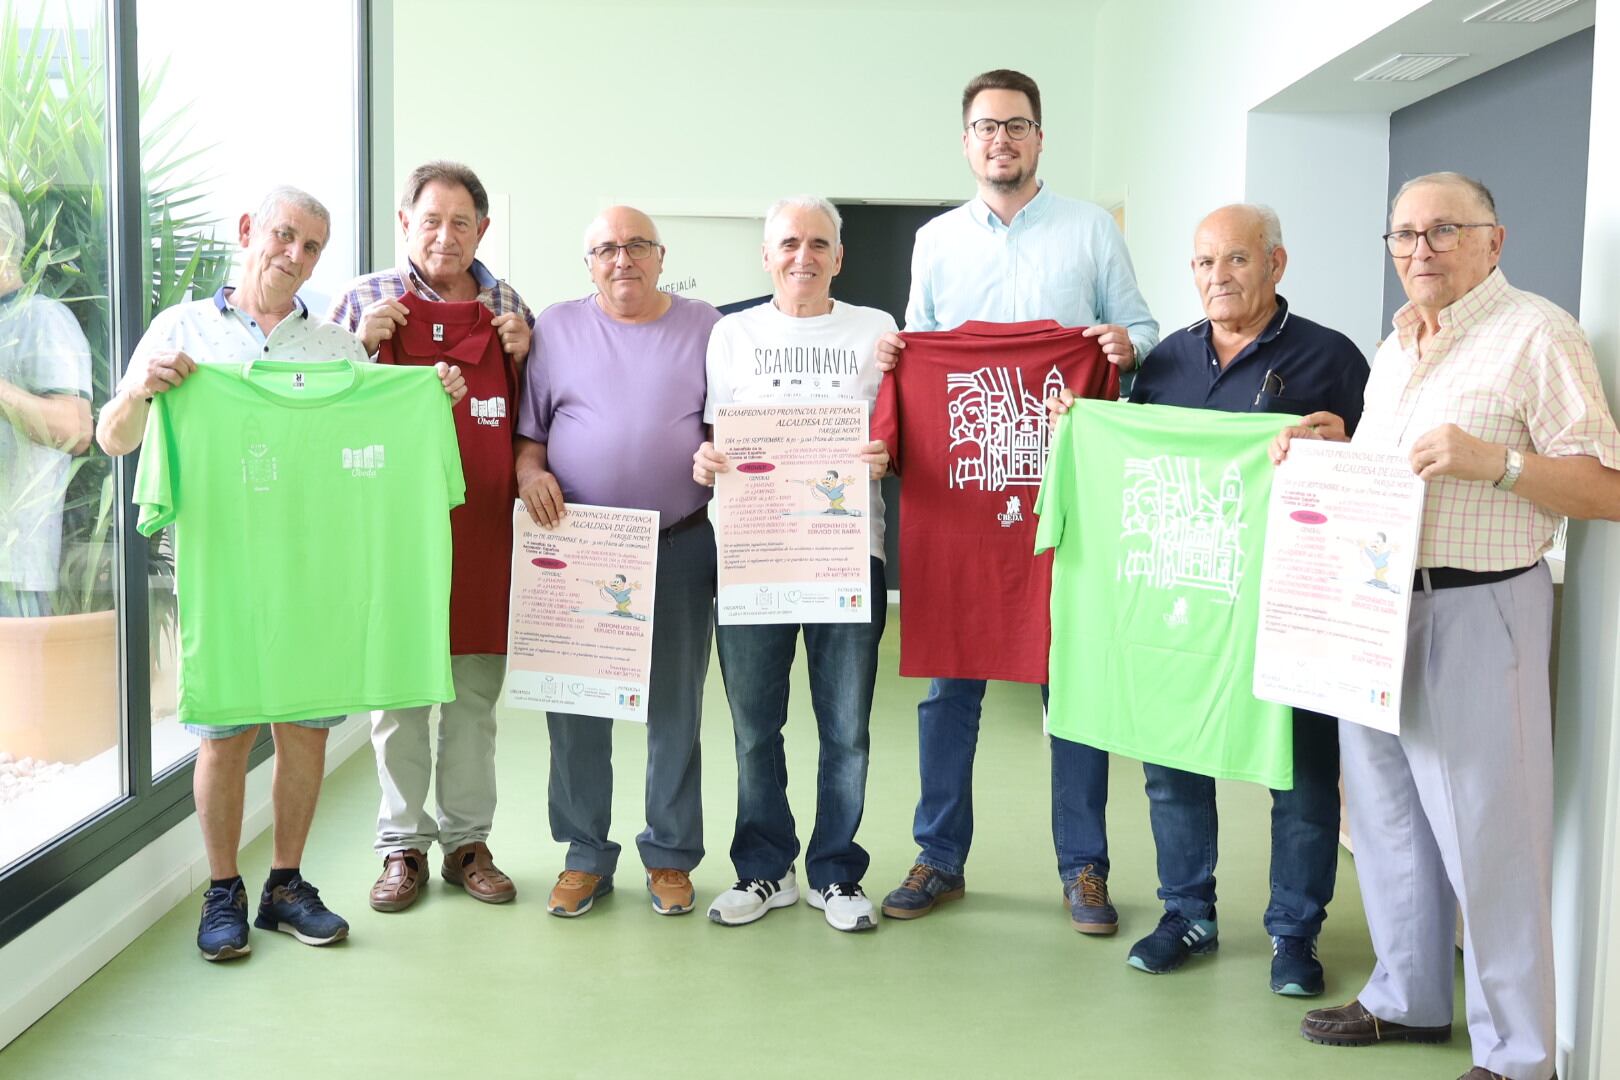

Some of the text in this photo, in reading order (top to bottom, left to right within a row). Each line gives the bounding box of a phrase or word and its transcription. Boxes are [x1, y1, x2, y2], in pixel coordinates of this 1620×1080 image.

[754, 346, 860, 376] SCANDINAVIA
[718, 407, 861, 417] III CAMPEONATO PROVINCIAL DE PETANCA
[775, 418, 820, 427] ALCALDESA
[822, 418, 833, 426] DE
[818, 427, 841, 435] PARQUE
[751, 436, 784, 444] SEPTIEMBRE
[571, 510, 611, 521] PROVINCIAL
[611, 513, 621, 521] DE
[621, 514, 652, 524] PETANCA
[569, 520, 613, 531] ALCALDESA
[614, 523, 626, 532] DE
